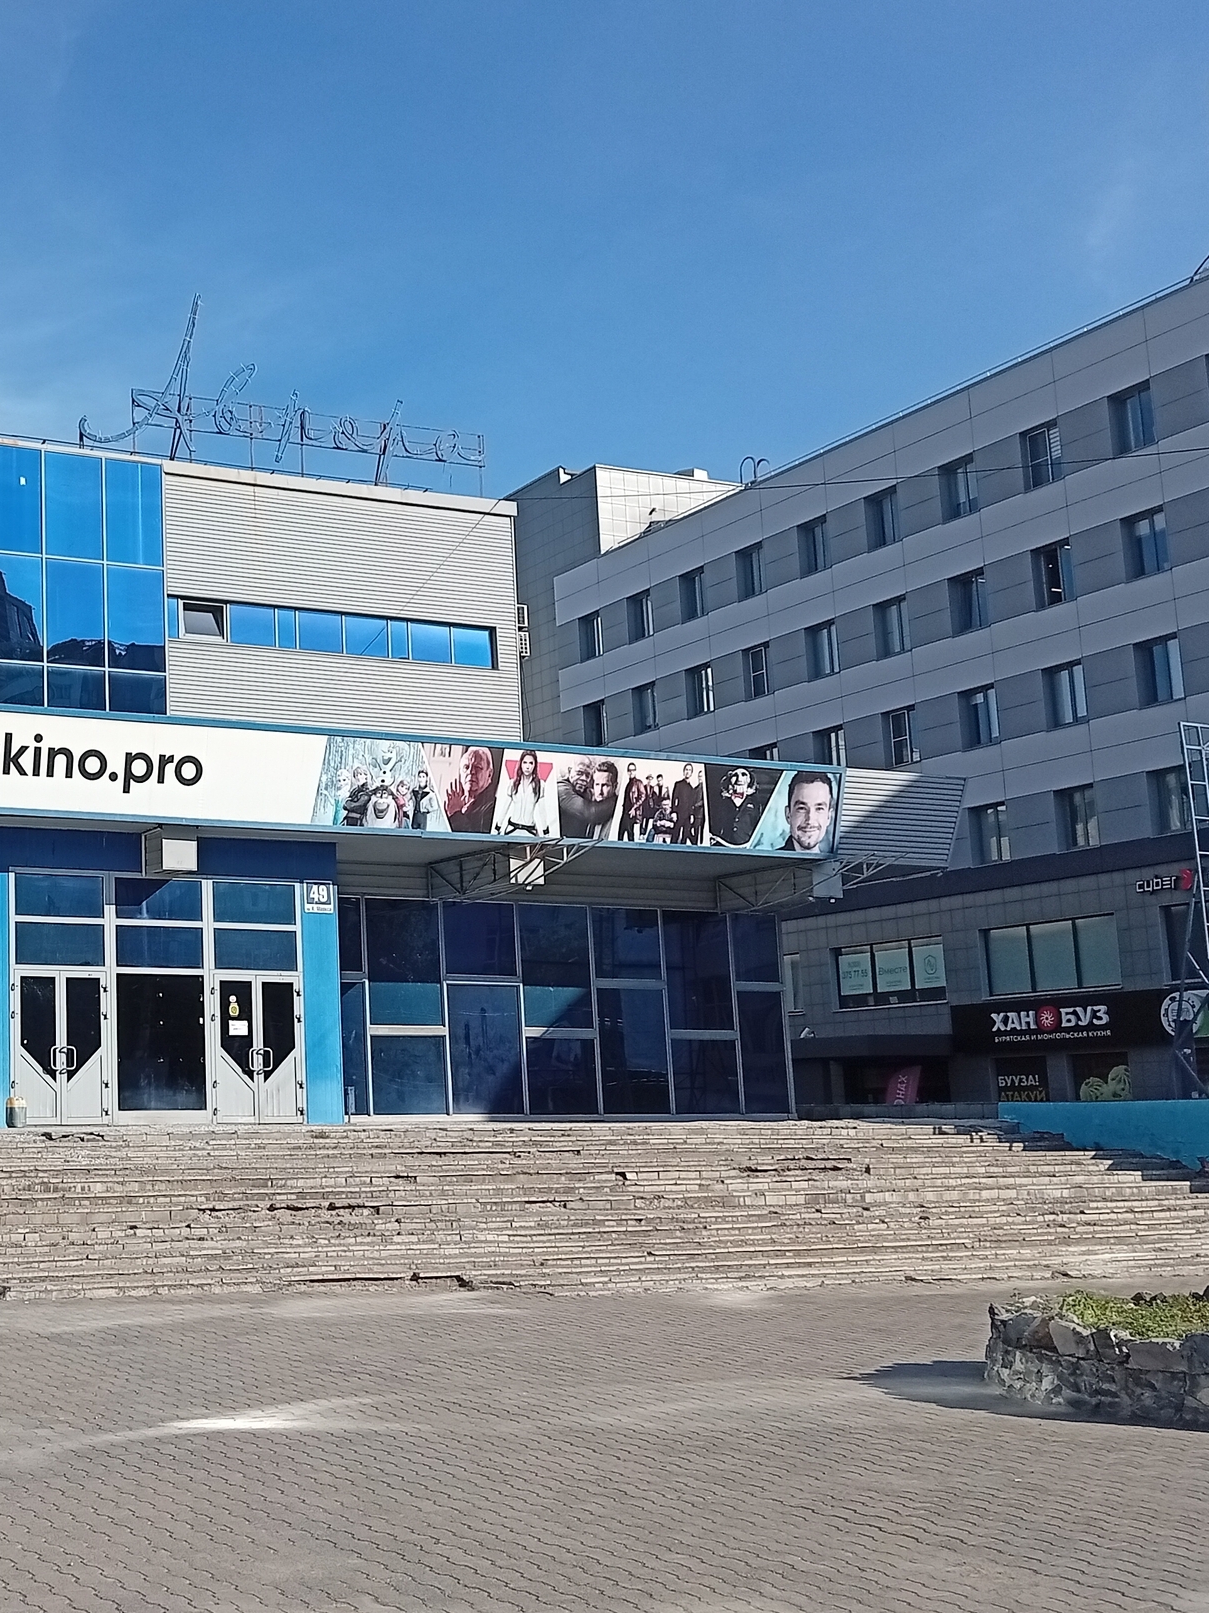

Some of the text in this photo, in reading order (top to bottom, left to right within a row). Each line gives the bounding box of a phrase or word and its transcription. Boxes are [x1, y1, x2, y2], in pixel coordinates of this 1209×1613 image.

[310, 884, 328, 903] 49
[853, 969, 860, 977] 77
[878, 966, 907, 976] Вместе
[990, 1005, 1110, 1031] ХАН БУЗ
[994, 1034, 1030, 1043] БУРЯТСКАЯ
[1037, 1030, 1088, 1041] МОНГОЛЬСКАЯ
[1088, 1029, 1112, 1037] КУХНЯ
[998, 1074, 1040, 1087] БУУЗА!
[1000, 1088, 1046, 1101] АТАКУЙ
